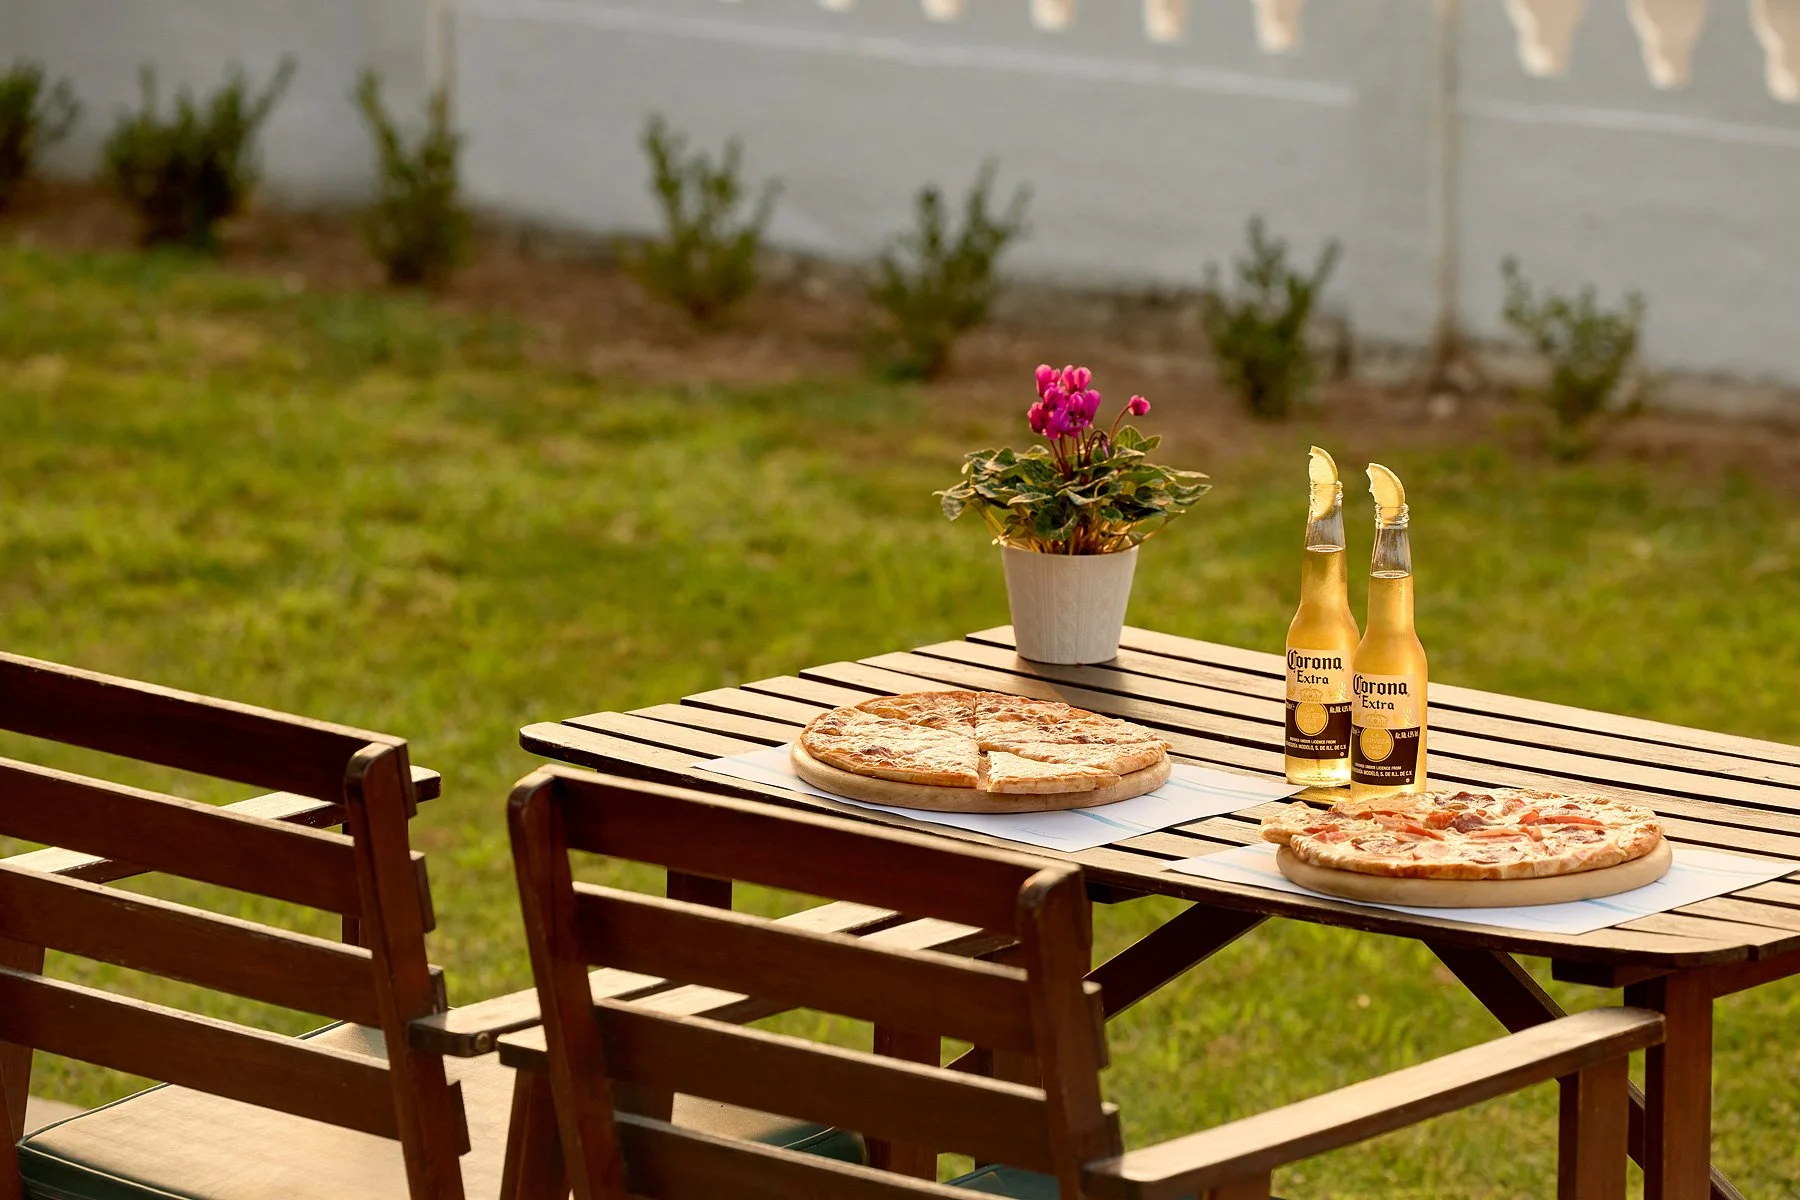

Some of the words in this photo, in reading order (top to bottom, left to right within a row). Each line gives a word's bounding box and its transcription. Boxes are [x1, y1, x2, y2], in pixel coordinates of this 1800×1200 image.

[1288, 649, 1342, 673] Corona
[1297, 670, 1329, 684] Extra
[1353, 674, 1408, 698] Corona
[1362, 695, 1394, 710] Extra
